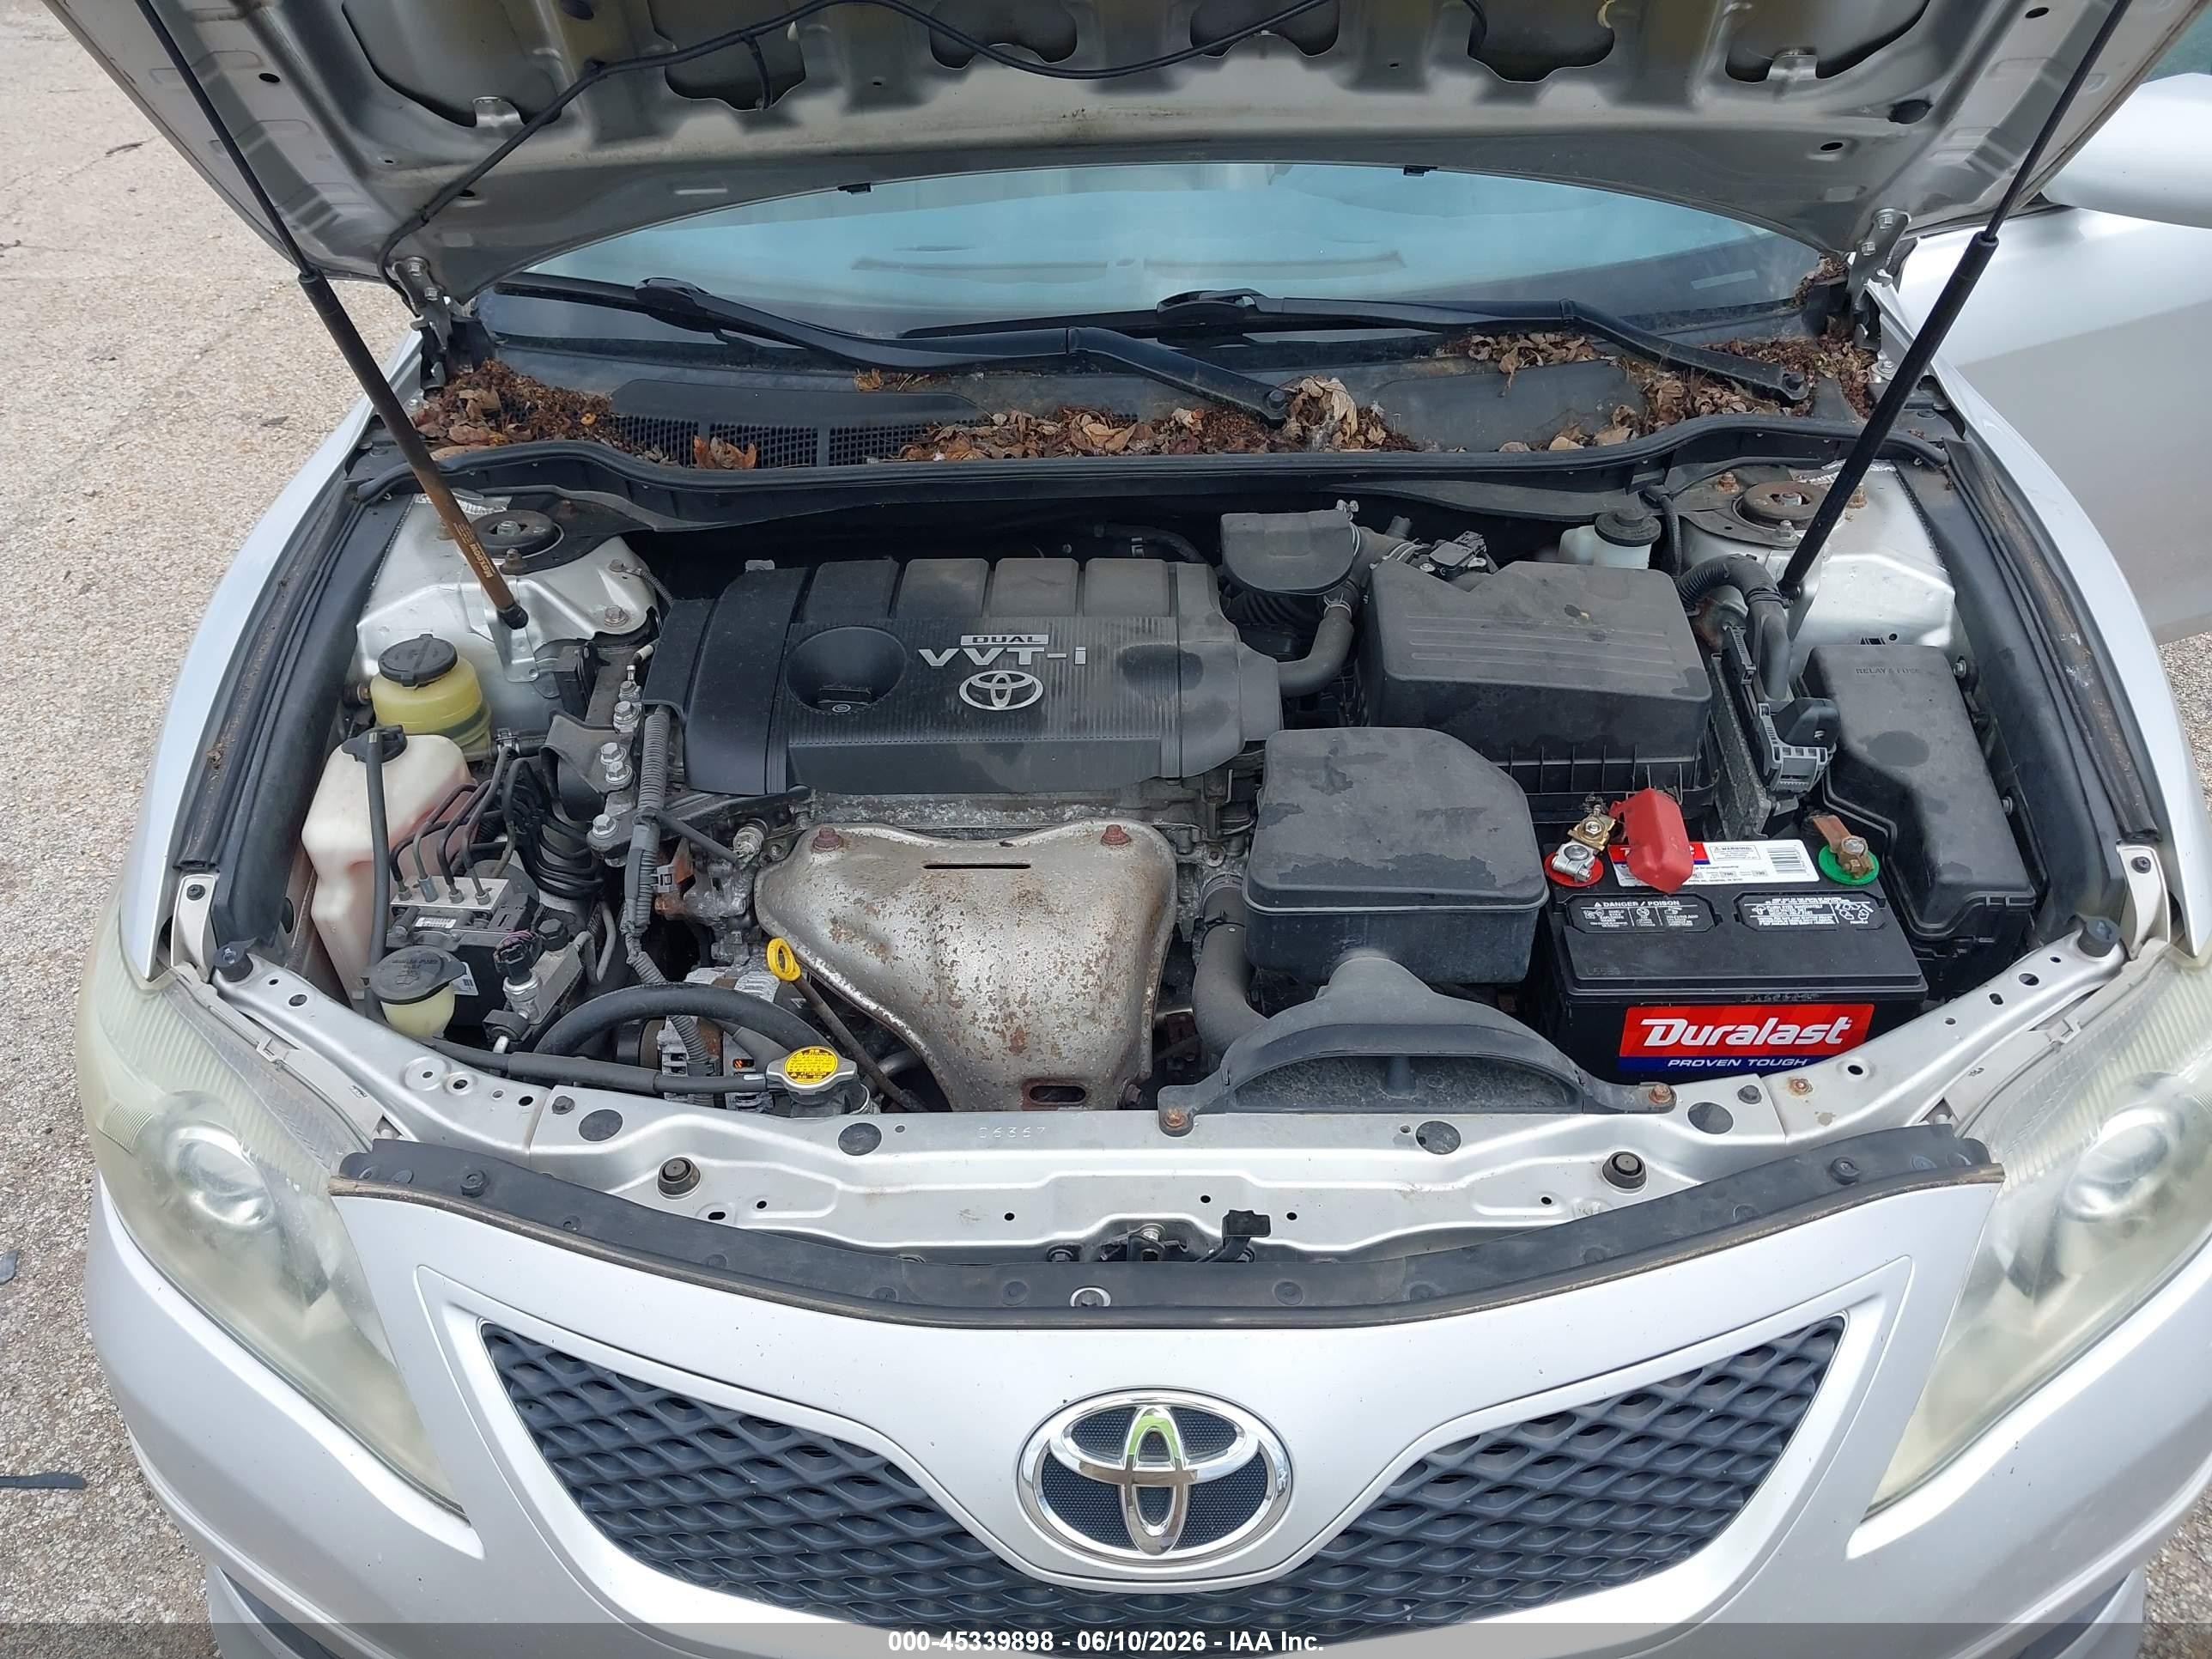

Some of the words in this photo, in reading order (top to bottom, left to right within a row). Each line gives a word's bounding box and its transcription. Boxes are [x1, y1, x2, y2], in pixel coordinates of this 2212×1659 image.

[918, 647, 1086, 666] VVT-i
[1640, 1017, 1851, 1047] Duralast
[1668, 1059, 1742, 1067] PROVEN
[1748, 1058, 1808, 1066] TOUGH
